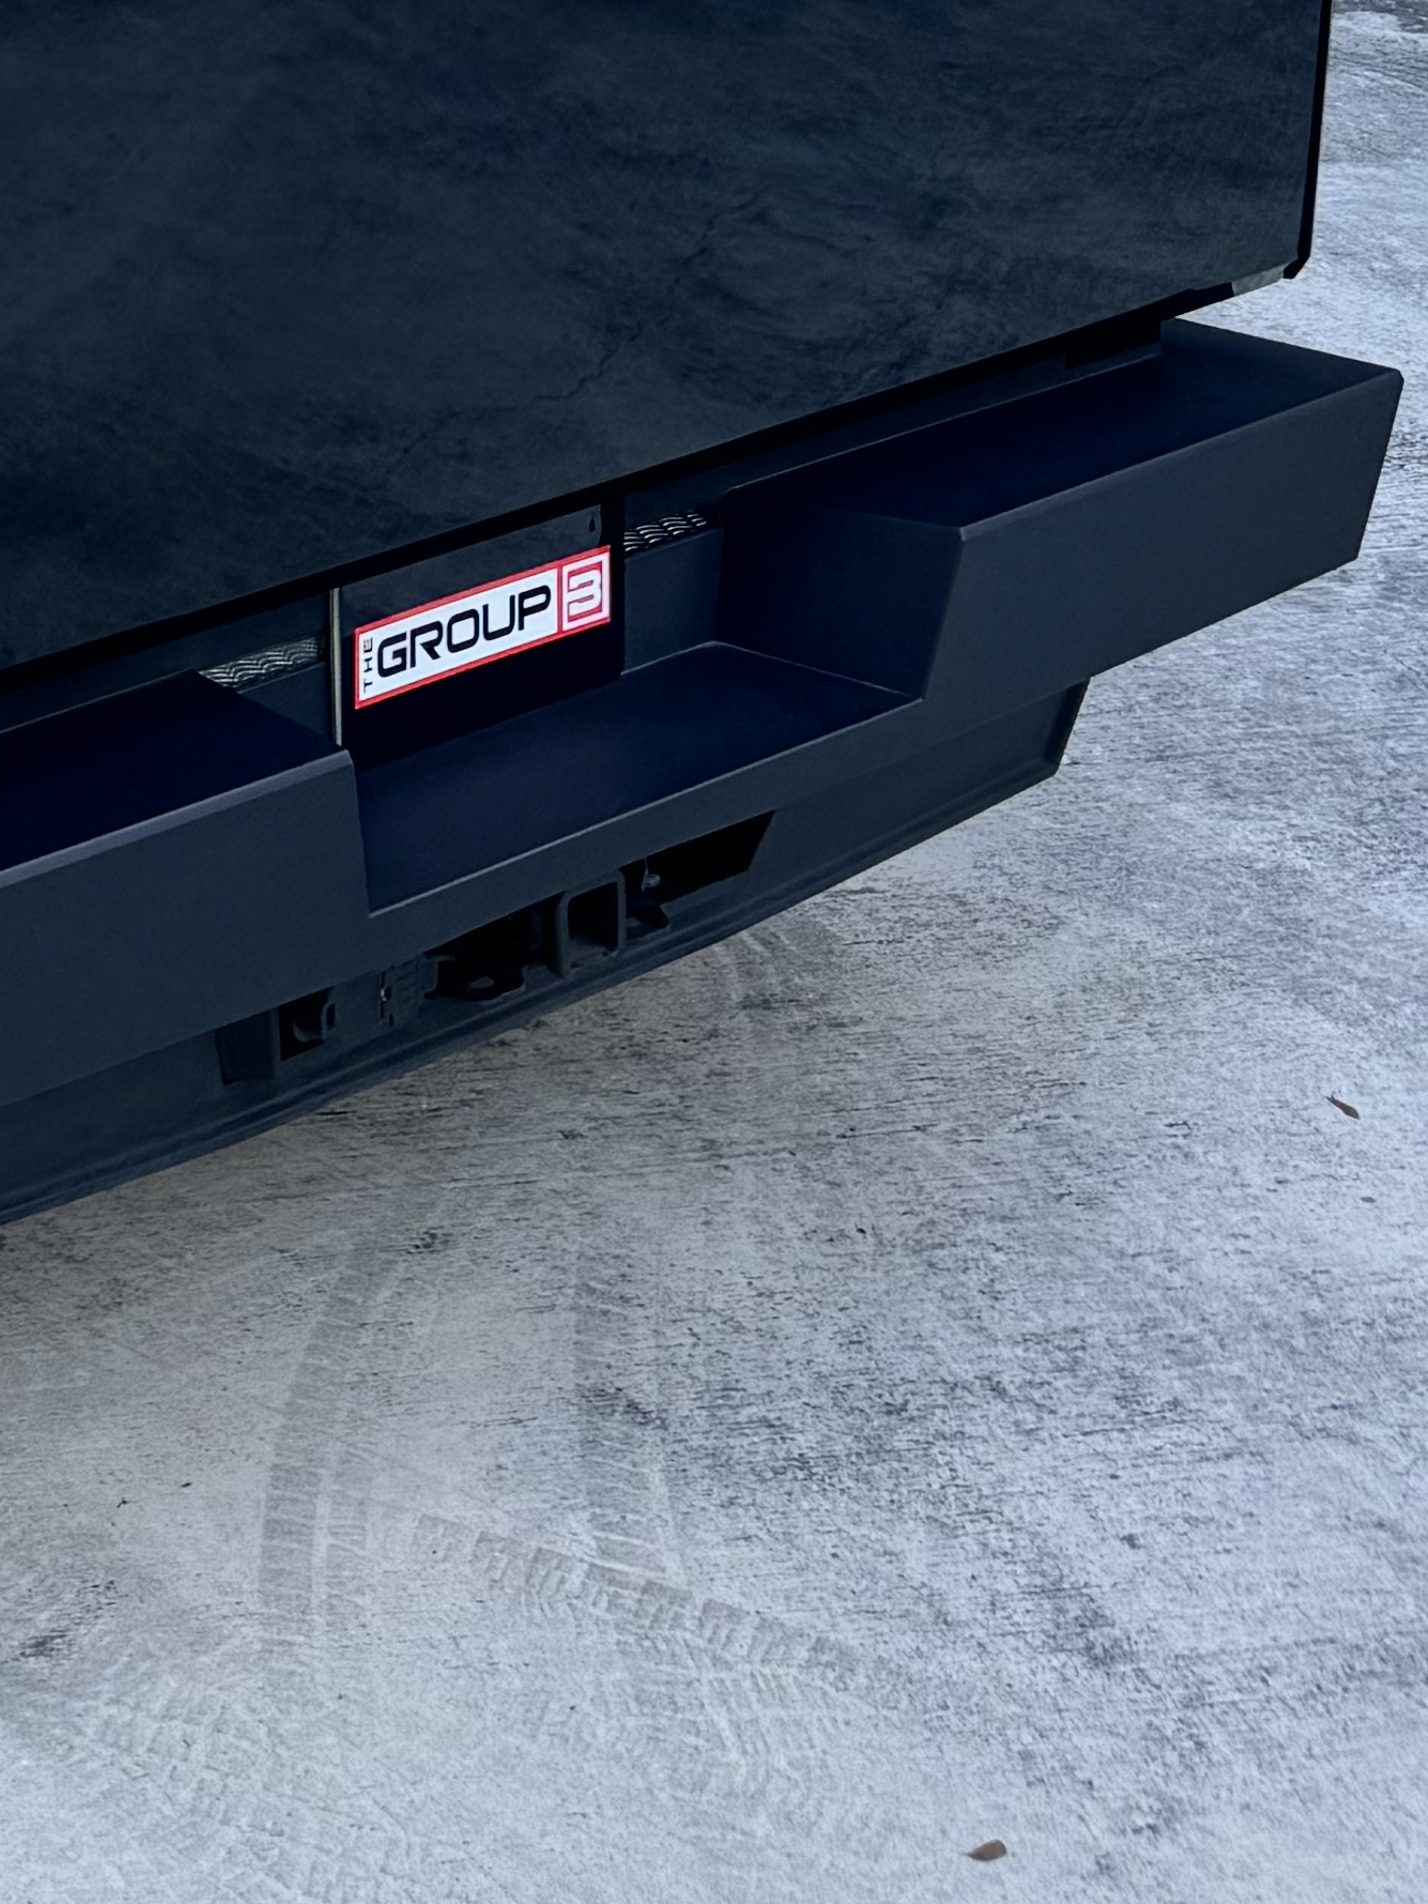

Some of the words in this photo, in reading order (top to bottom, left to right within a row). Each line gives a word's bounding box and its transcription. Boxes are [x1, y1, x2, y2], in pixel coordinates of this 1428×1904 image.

[377, 584, 552, 679] GROUP
[566, 559, 604, 624] 3
[363, 636, 374, 694] THE
